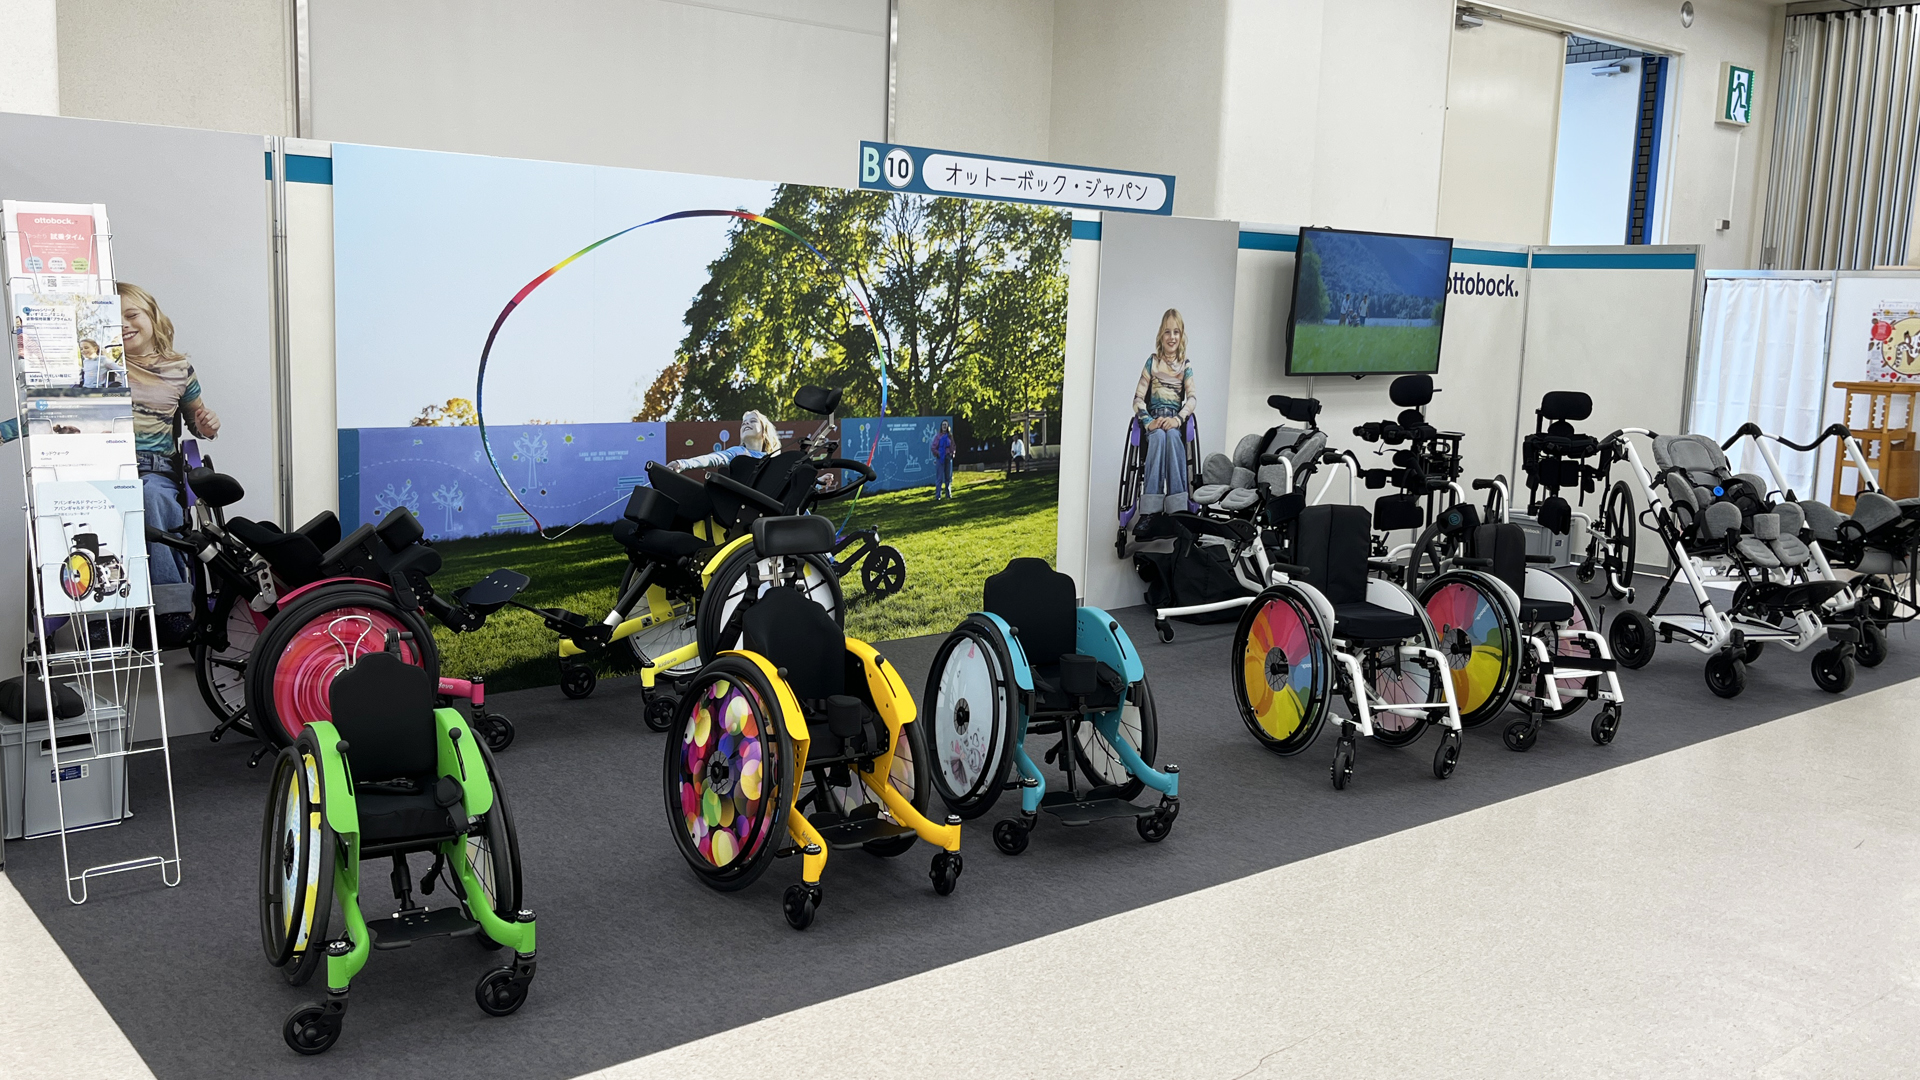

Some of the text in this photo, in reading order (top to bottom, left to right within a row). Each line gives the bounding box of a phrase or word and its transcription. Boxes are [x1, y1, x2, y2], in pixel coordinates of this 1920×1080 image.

[862, 146, 1149, 202] B 10 オットーボック・ジャパン
[34, 217, 75, 225] ottobock.
